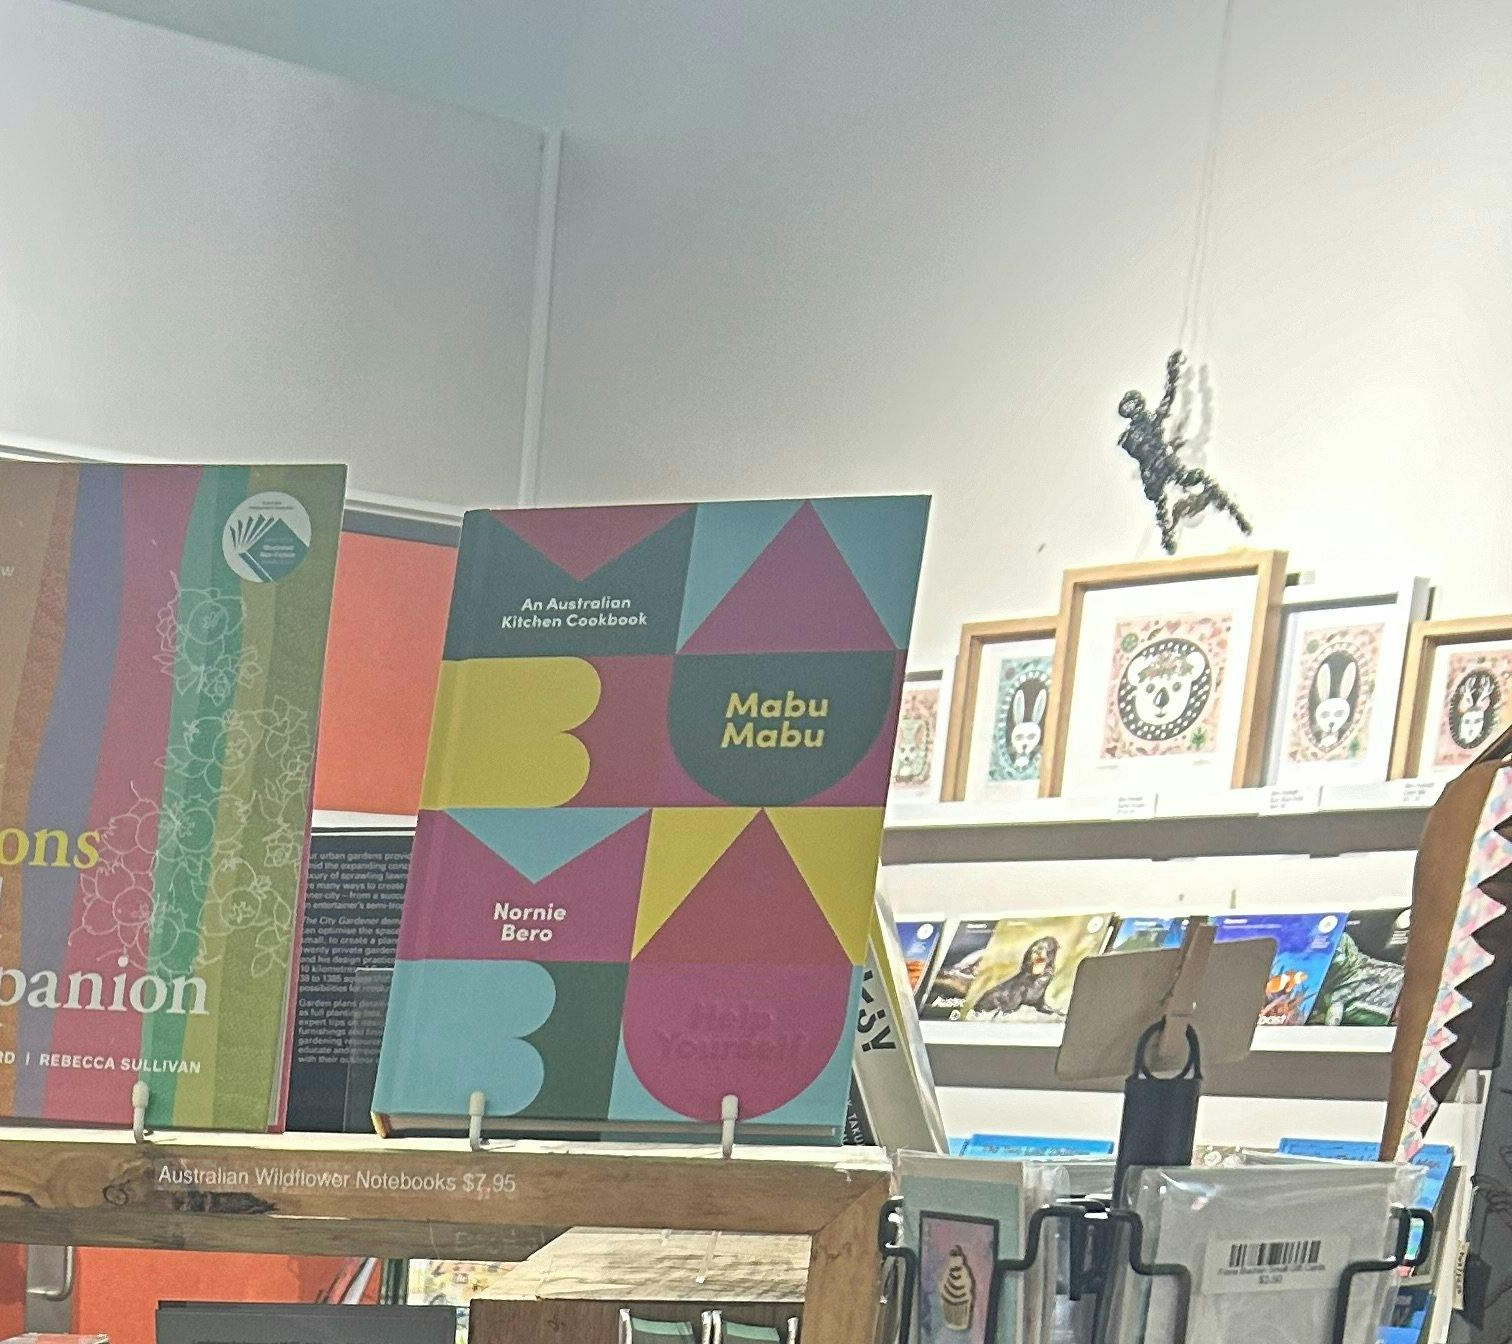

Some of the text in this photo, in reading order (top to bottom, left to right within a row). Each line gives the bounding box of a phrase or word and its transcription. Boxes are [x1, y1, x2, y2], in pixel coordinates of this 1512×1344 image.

[521, 596, 631, 611] An Australian
[501, 612, 648, 630] Kitchen Cookbook
[726, 691, 829, 718] Mabu
[720, 721, 825, 748] Mabu
[493, 903, 566, 922] Nornie
[501, 924, 553, 942] Bero
[39, 1053, 115, 1071] REBECCA
[120, 1057, 201, 1074] SULLIVAN
[158, 1166, 516, 1193] Australian Wildflower Notebooks $7.95
